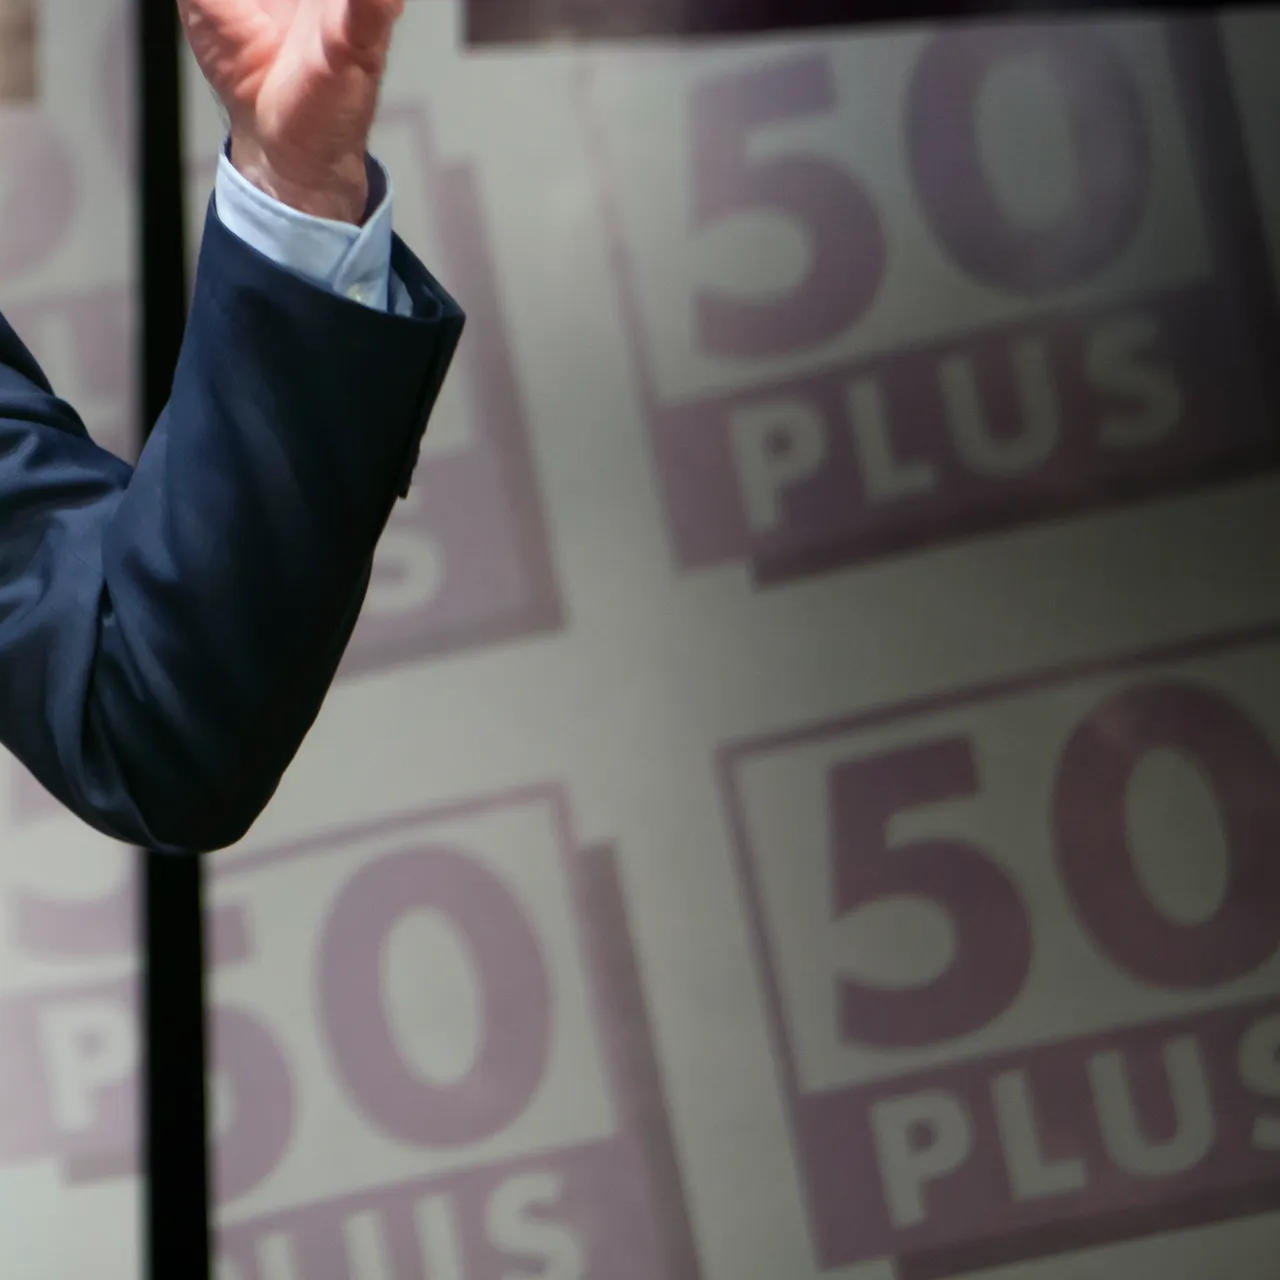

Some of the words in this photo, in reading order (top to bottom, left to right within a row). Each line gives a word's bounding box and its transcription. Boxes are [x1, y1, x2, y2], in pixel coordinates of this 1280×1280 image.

[692, 30, 1146, 358] 50
[730, 318, 1184, 534] PLUS
[828, 678, 1280, 1050] 50
